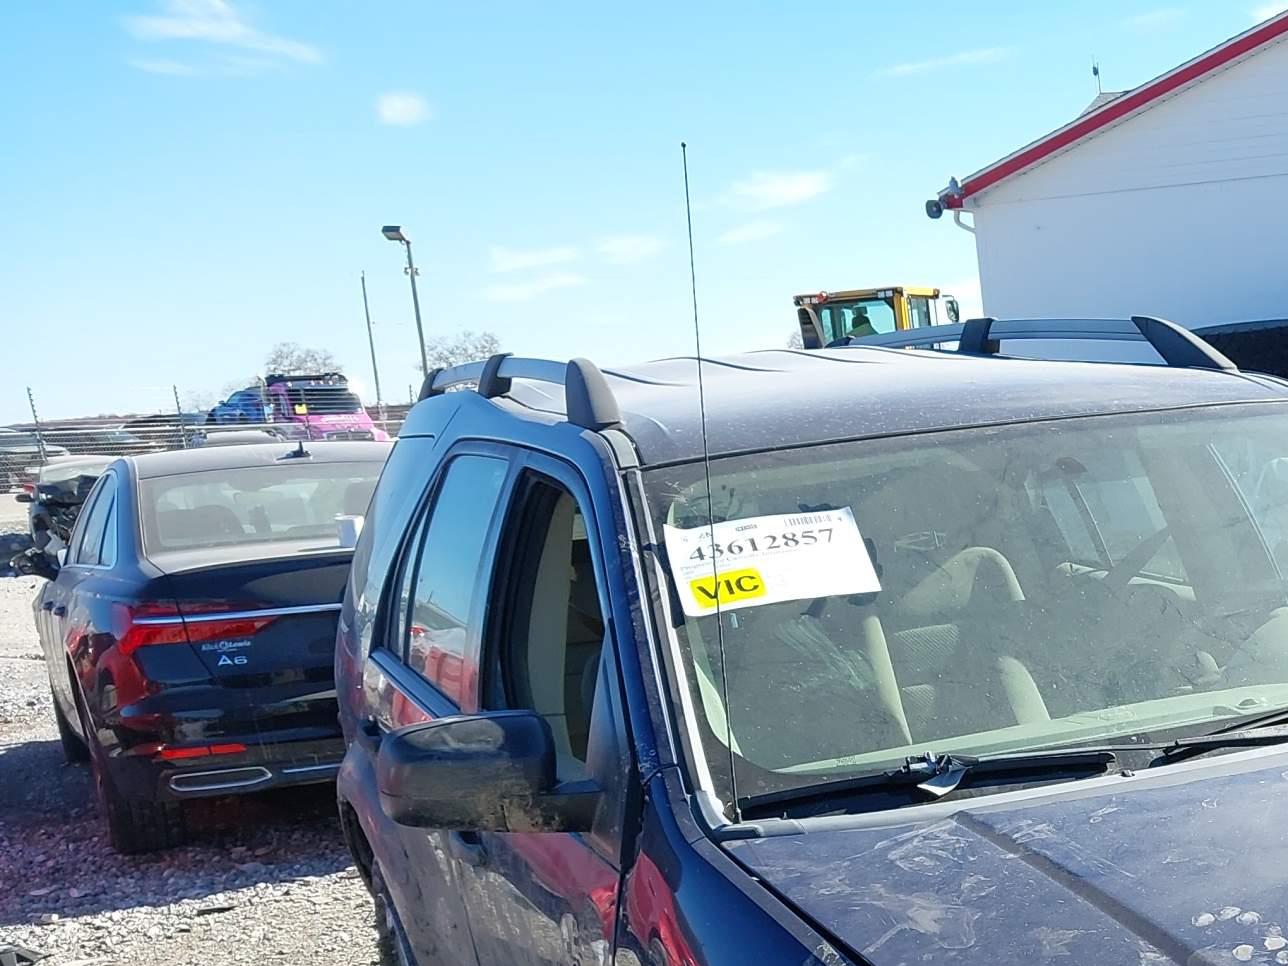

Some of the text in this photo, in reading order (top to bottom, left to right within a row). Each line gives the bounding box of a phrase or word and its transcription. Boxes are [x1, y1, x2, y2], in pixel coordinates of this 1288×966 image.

[689, 527, 834, 562] 43612857
[696, 575, 760, 600] VIC
[217, 654, 248, 667] A6
